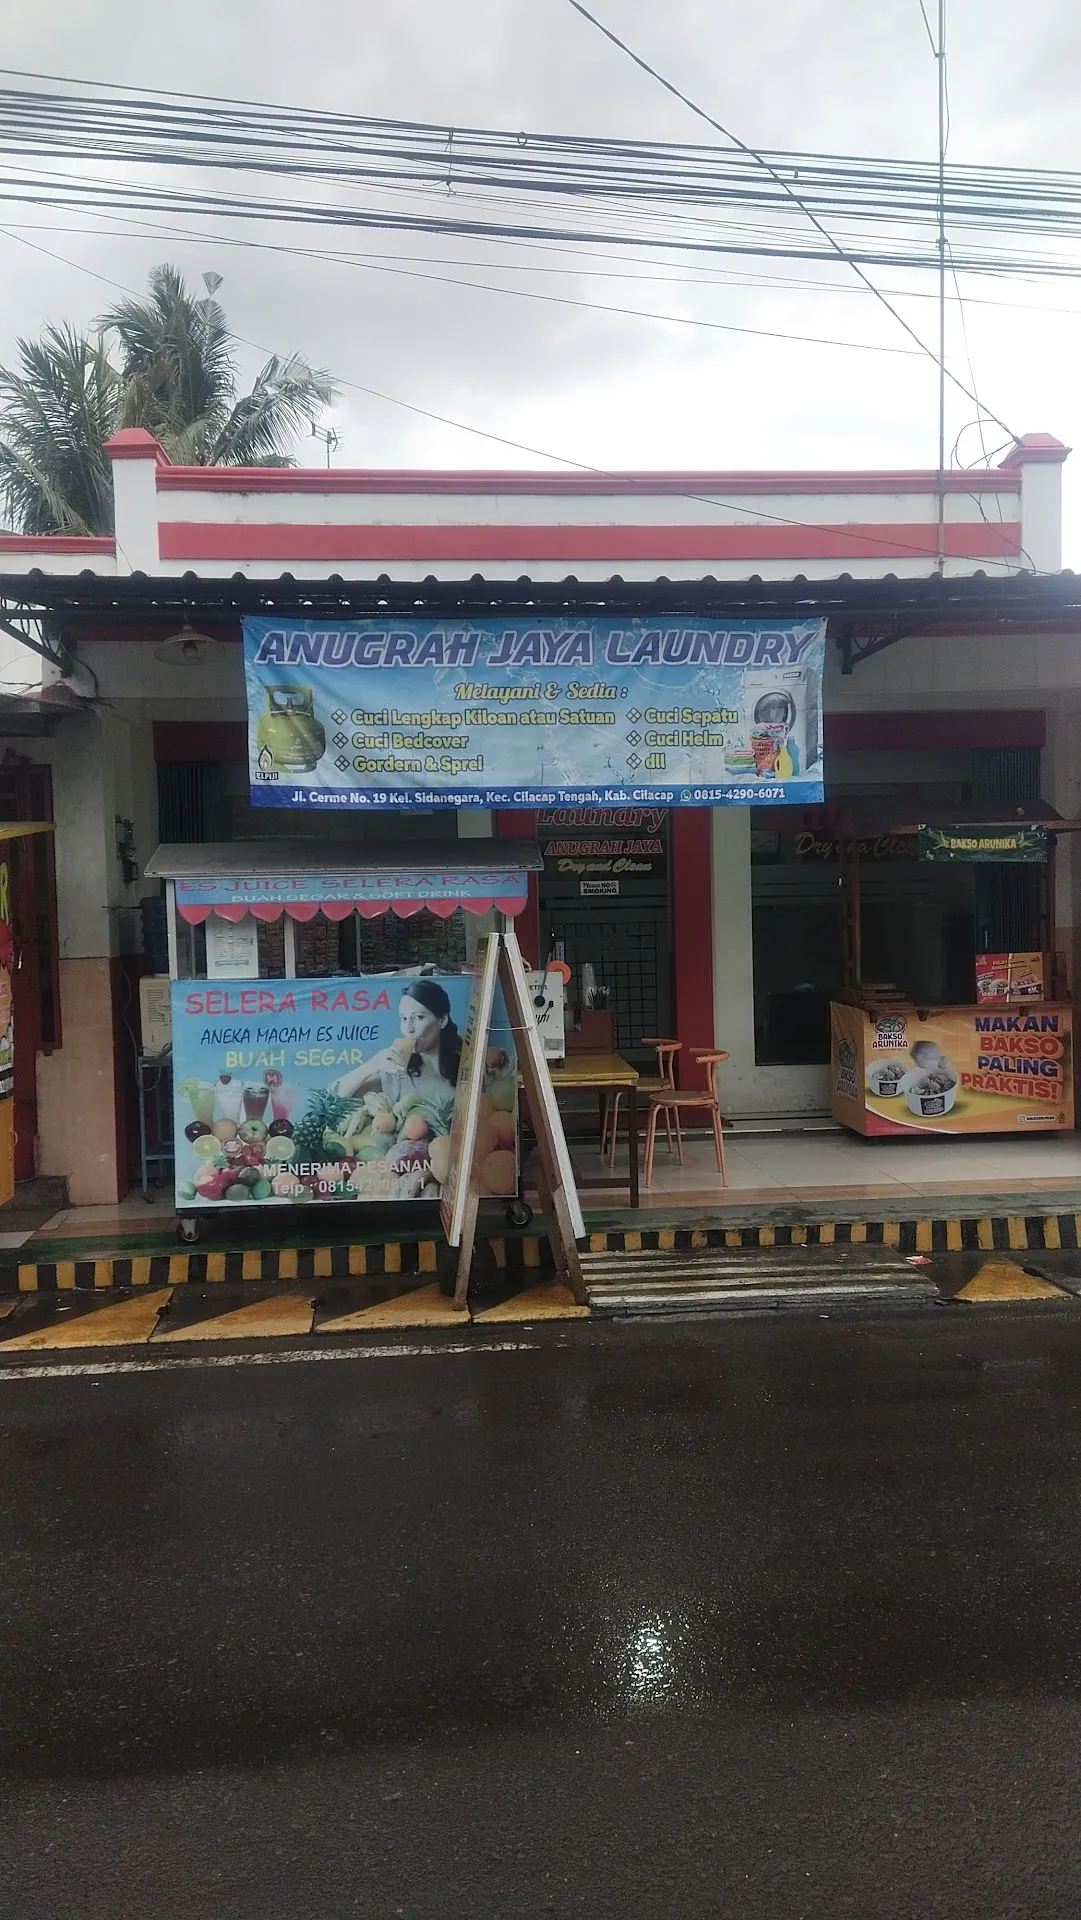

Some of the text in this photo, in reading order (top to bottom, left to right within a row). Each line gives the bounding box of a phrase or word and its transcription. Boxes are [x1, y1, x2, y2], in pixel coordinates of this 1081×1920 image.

[254, 629, 817, 668] ANUGRAH JAYA LAUNDRY
[455, 682, 539, 704] Melayani
[545, 682, 562, 699] &
[566, 682, 617, 699] Sedia
[351, 709, 615, 729] Cuci Lengkap Kiloan atau Satuan
[645, 708, 738, 728] Cuci Sepatu
[352, 732, 469, 749] Cuci Bedcover
[645, 730, 723, 747] Cuci Helm
[353, 756, 483, 775] Gordern & Sprei
[645, 753, 666, 770] dll
[256, 772, 278, 780] ELPIJI
[292, 791, 306, 803] Jl.
[309, 792, 347, 803] Cerme
[350, 792, 370, 803] No.
[372, 792, 386, 803] 19
[415, 791, 483, 806] Sidanegara,
[486, 791, 510, 803] Kec.
[514, 791, 555, 805] Cilacap
[559, 791, 602, 804] Tengah,
[604, 790, 630, 801] Kab.
[633, 790, 674, 803] Cilacap
[694, 788, 785, 800] 0815-4290-6071
[536, 807, 669, 833] Laundry
[544, 839, 663, 856] ANUGRAH JAYA
[950, 838, 1017, 850] BAKSO ARUNIKA
[558, 857, 652, 875] Dry and Clean
[179, 874, 520, 892] ES JUICE SELERA RASA
[232, 890, 471, 902] BUAH SEGAR & SOFT DRINK
[184, 989, 391, 1016] SELERA RASA
[975, 1016, 1058, 1032] MAKAN
[200, 1024, 379, 1046] ANEKA MACAM ES JUICE
[872, 1040, 908, 1049] ARUNIKA
[980, 1036, 1059, 1055] BAKSO
[226, 1049, 364, 1069] BUAH SEGAR
[978, 1056, 1058, 1077] PALING
[960, 1072, 1058, 1099] PRAKTIS!
[263, 1159, 433, 1178] MENERIMA PESANAN
[272, 1182, 303, 1197] Telp
